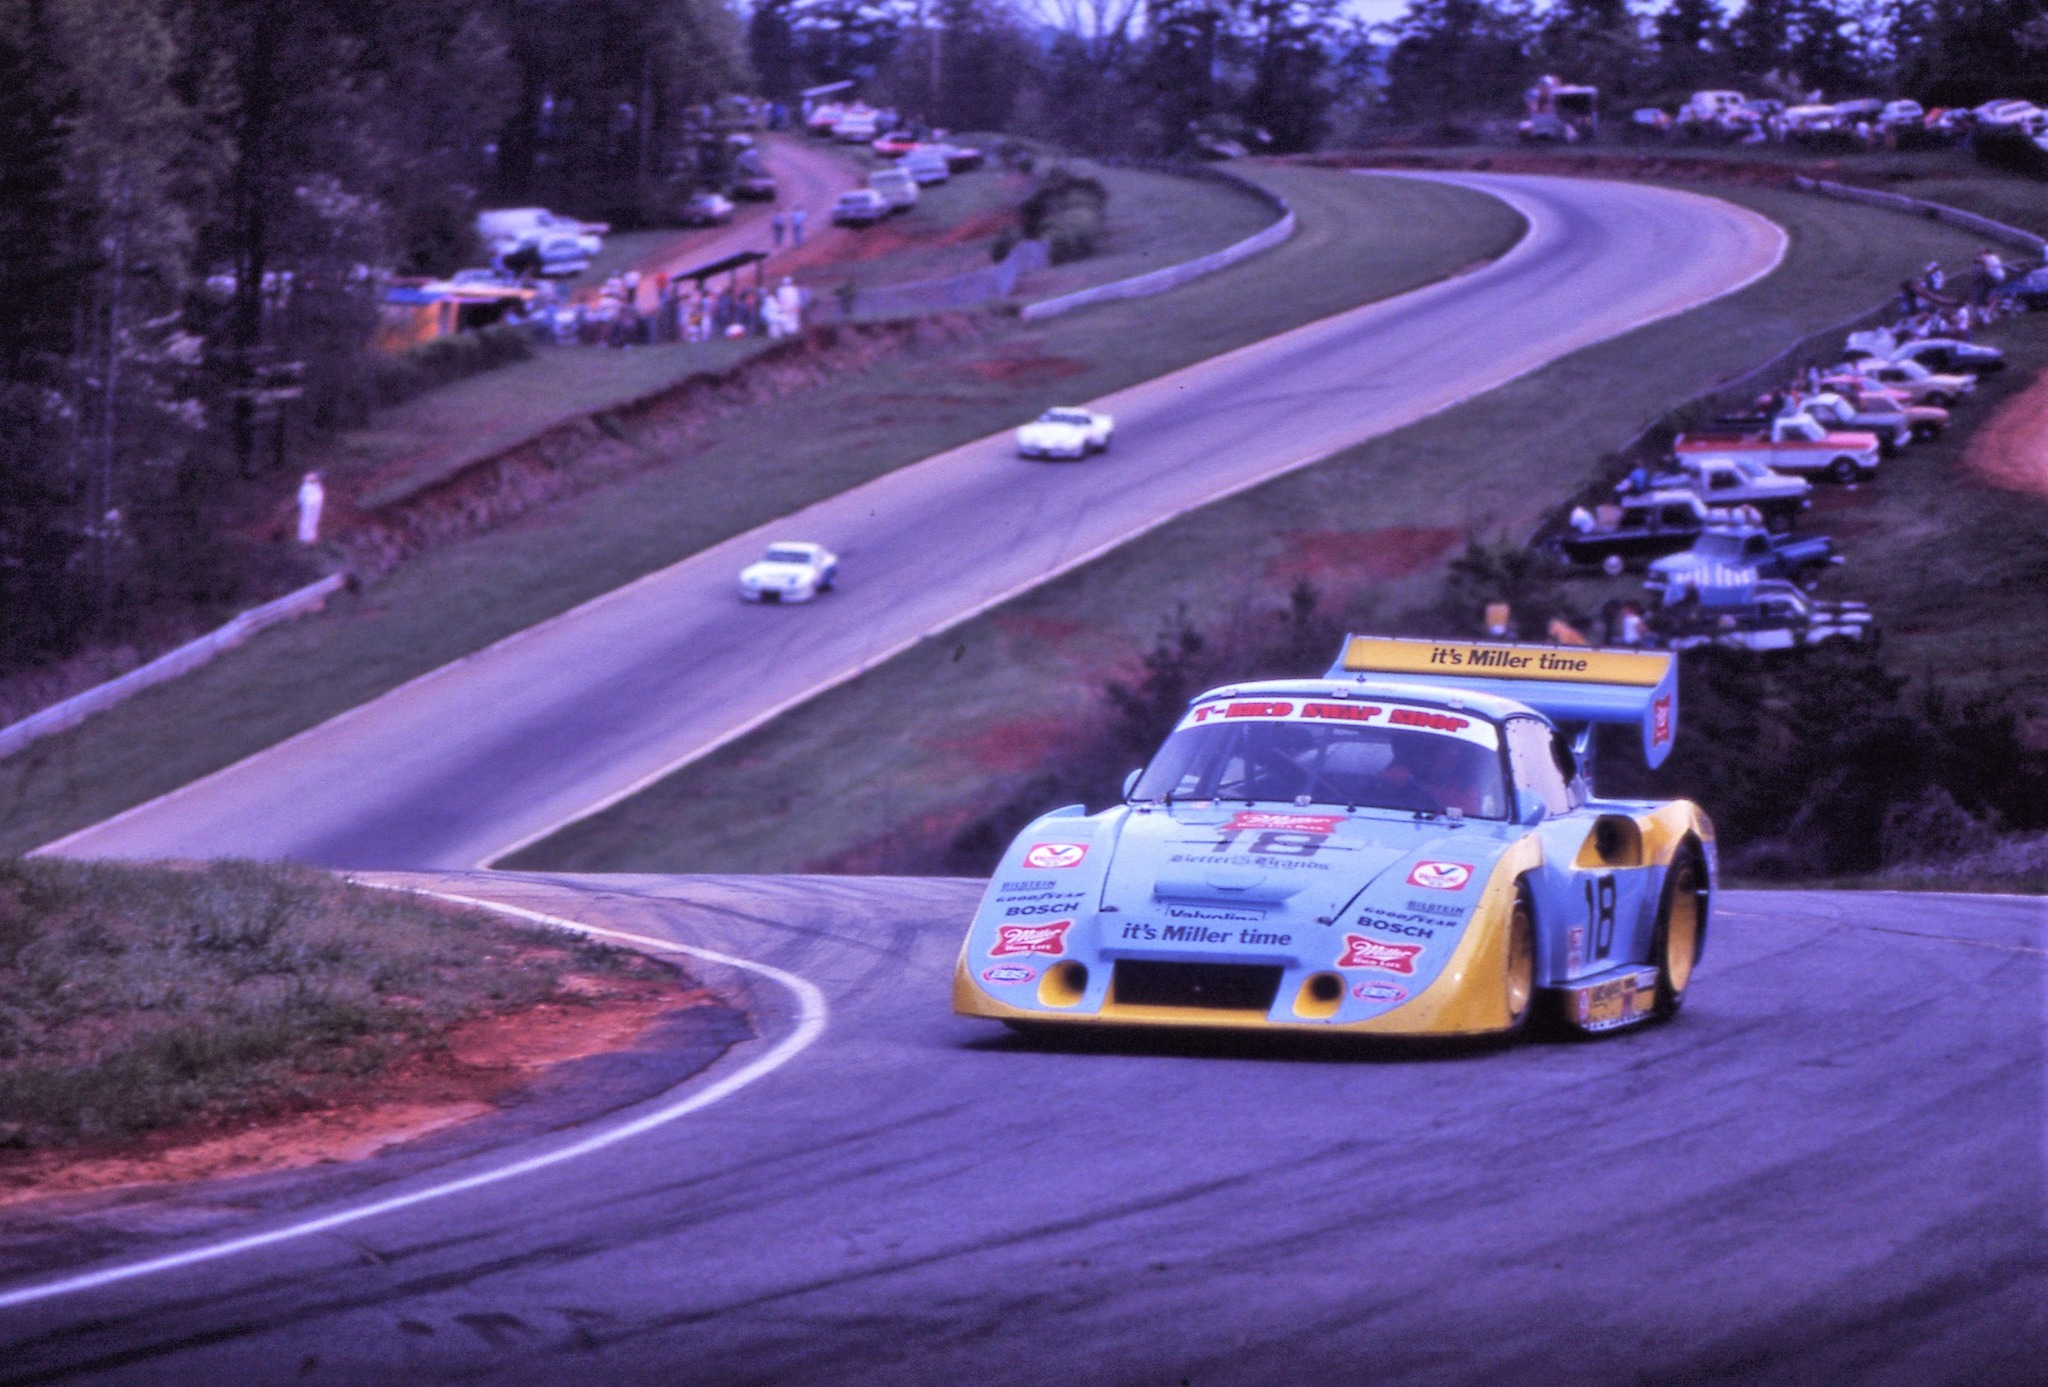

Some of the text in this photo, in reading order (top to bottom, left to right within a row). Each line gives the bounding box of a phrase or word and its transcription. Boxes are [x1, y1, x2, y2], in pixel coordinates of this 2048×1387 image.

[1431, 648, 1588, 672] it's Miller time
[1211, 830, 1330, 857] 18
[1005, 902, 1080, 917] BOSCH
[1584, 874, 1617, 963] 18
[1003, 928, 1062, 945] Miller
[1121, 922, 1293, 946] it's Miller time
[1357, 915, 1435, 939] BOSCH
[1351, 940, 1413, 961] Miller
